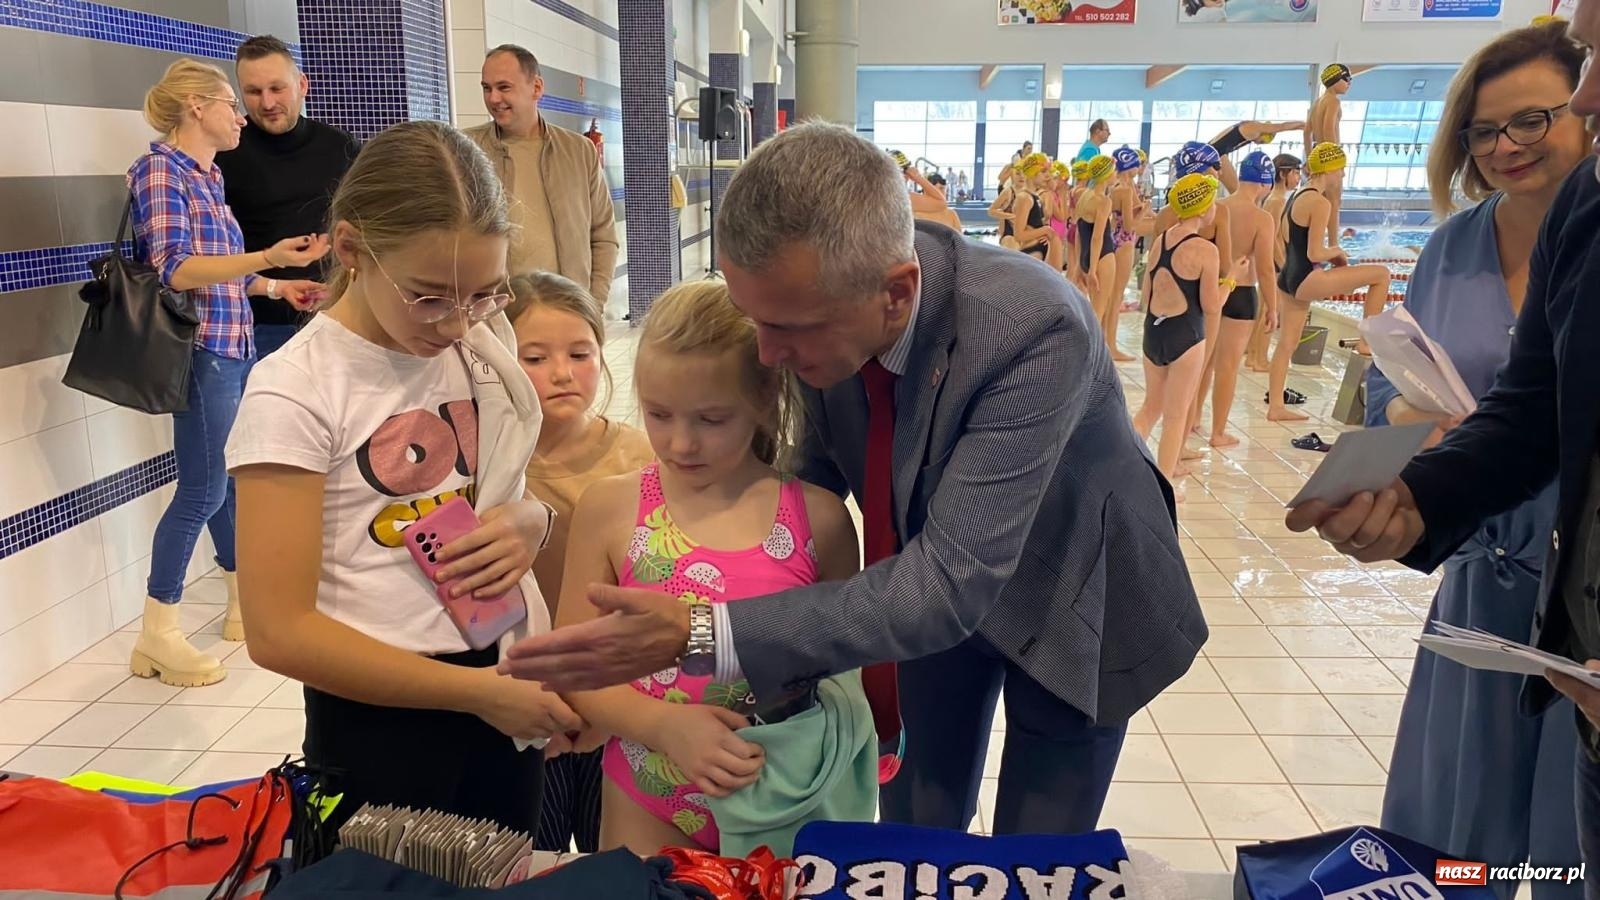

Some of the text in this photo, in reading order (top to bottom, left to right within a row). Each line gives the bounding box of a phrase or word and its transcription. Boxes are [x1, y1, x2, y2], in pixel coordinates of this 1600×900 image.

[1085, 13, 1099, 21] 510
[1100, 13, 1114, 21] 502
[1115, 13, 1130, 21] 282
